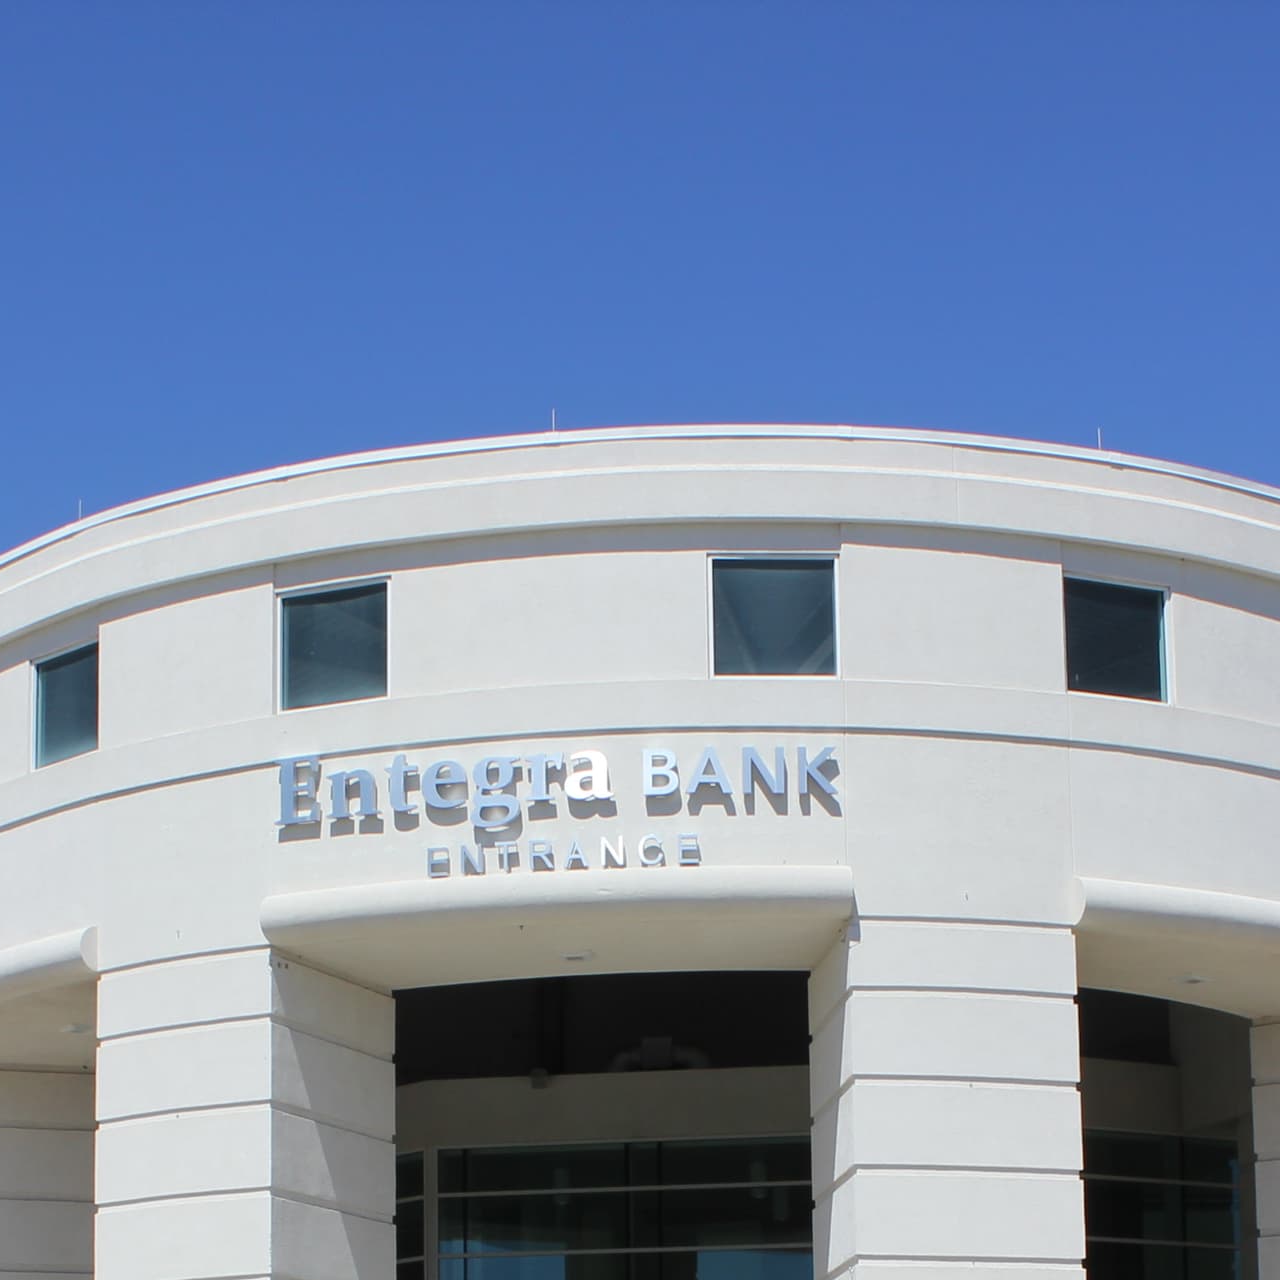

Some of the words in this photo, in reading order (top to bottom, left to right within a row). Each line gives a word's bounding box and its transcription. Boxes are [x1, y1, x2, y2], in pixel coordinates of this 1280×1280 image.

[275, 749, 615, 828] Entegra
[641, 745, 839, 798] BANK
[426, 833, 702, 877] ENTRANCE
